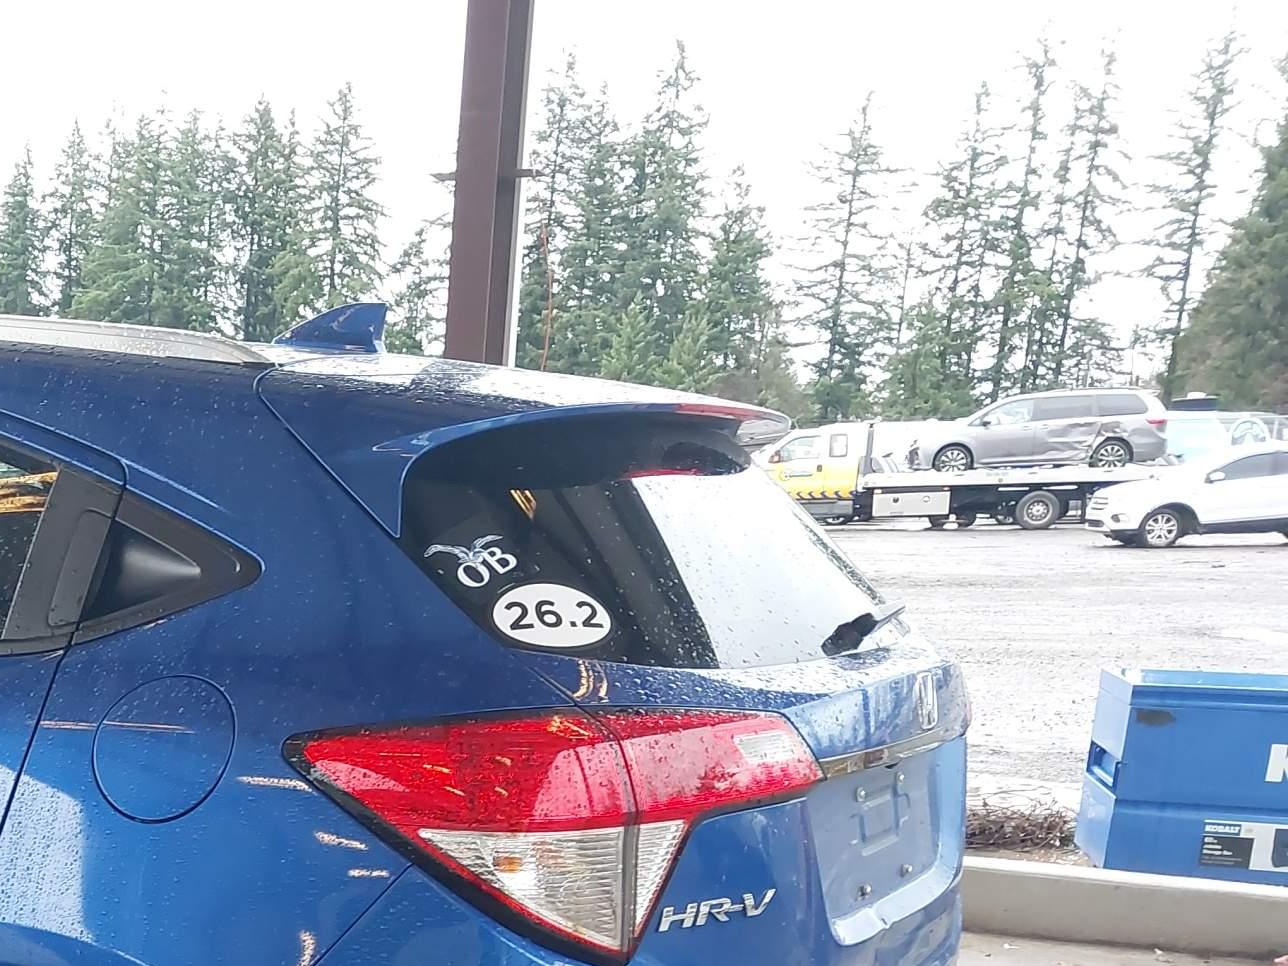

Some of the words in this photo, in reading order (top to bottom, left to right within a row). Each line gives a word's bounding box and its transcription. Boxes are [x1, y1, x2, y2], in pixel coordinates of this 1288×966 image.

[456, 546, 518, 588] OB
[503, 600, 605, 631] 26.2
[658, 888, 777, 933] HR-V
